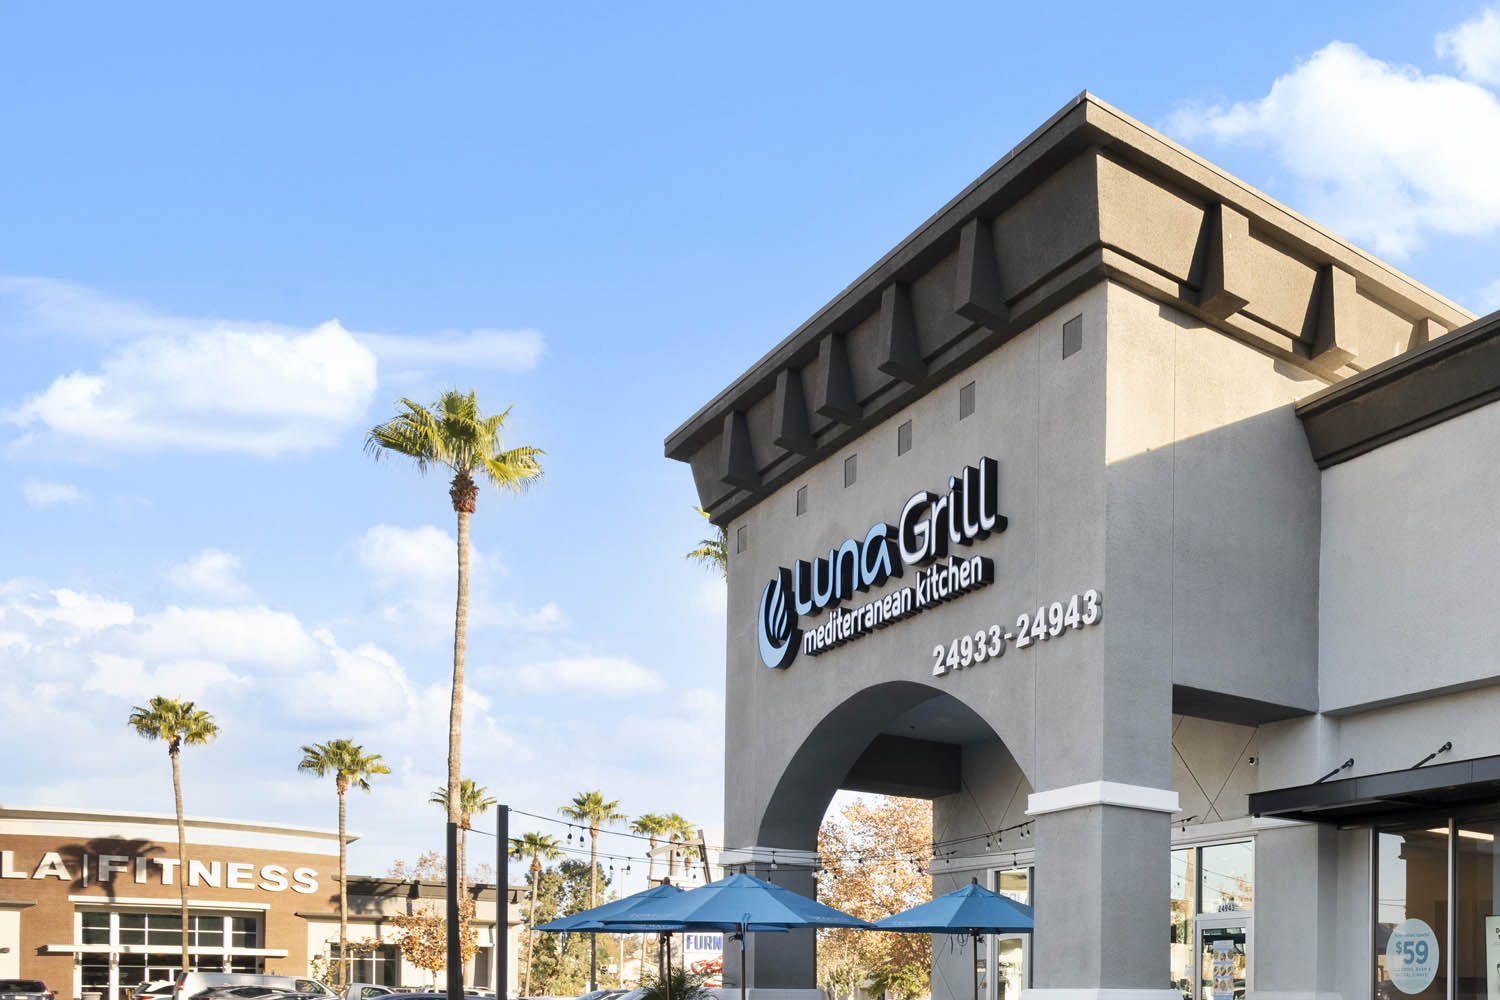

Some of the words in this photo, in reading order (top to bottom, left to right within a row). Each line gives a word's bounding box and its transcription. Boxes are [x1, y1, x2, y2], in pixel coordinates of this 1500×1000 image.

[898, 456, 998, 565] Grill
[803, 587, 914, 656] mediterranean
[915, 555, 986, 607] kitchen
[1, 850, 72, 881] LA
[98, 854, 320, 894] FITNESS
[1396, 940, 1429, 965] $59
